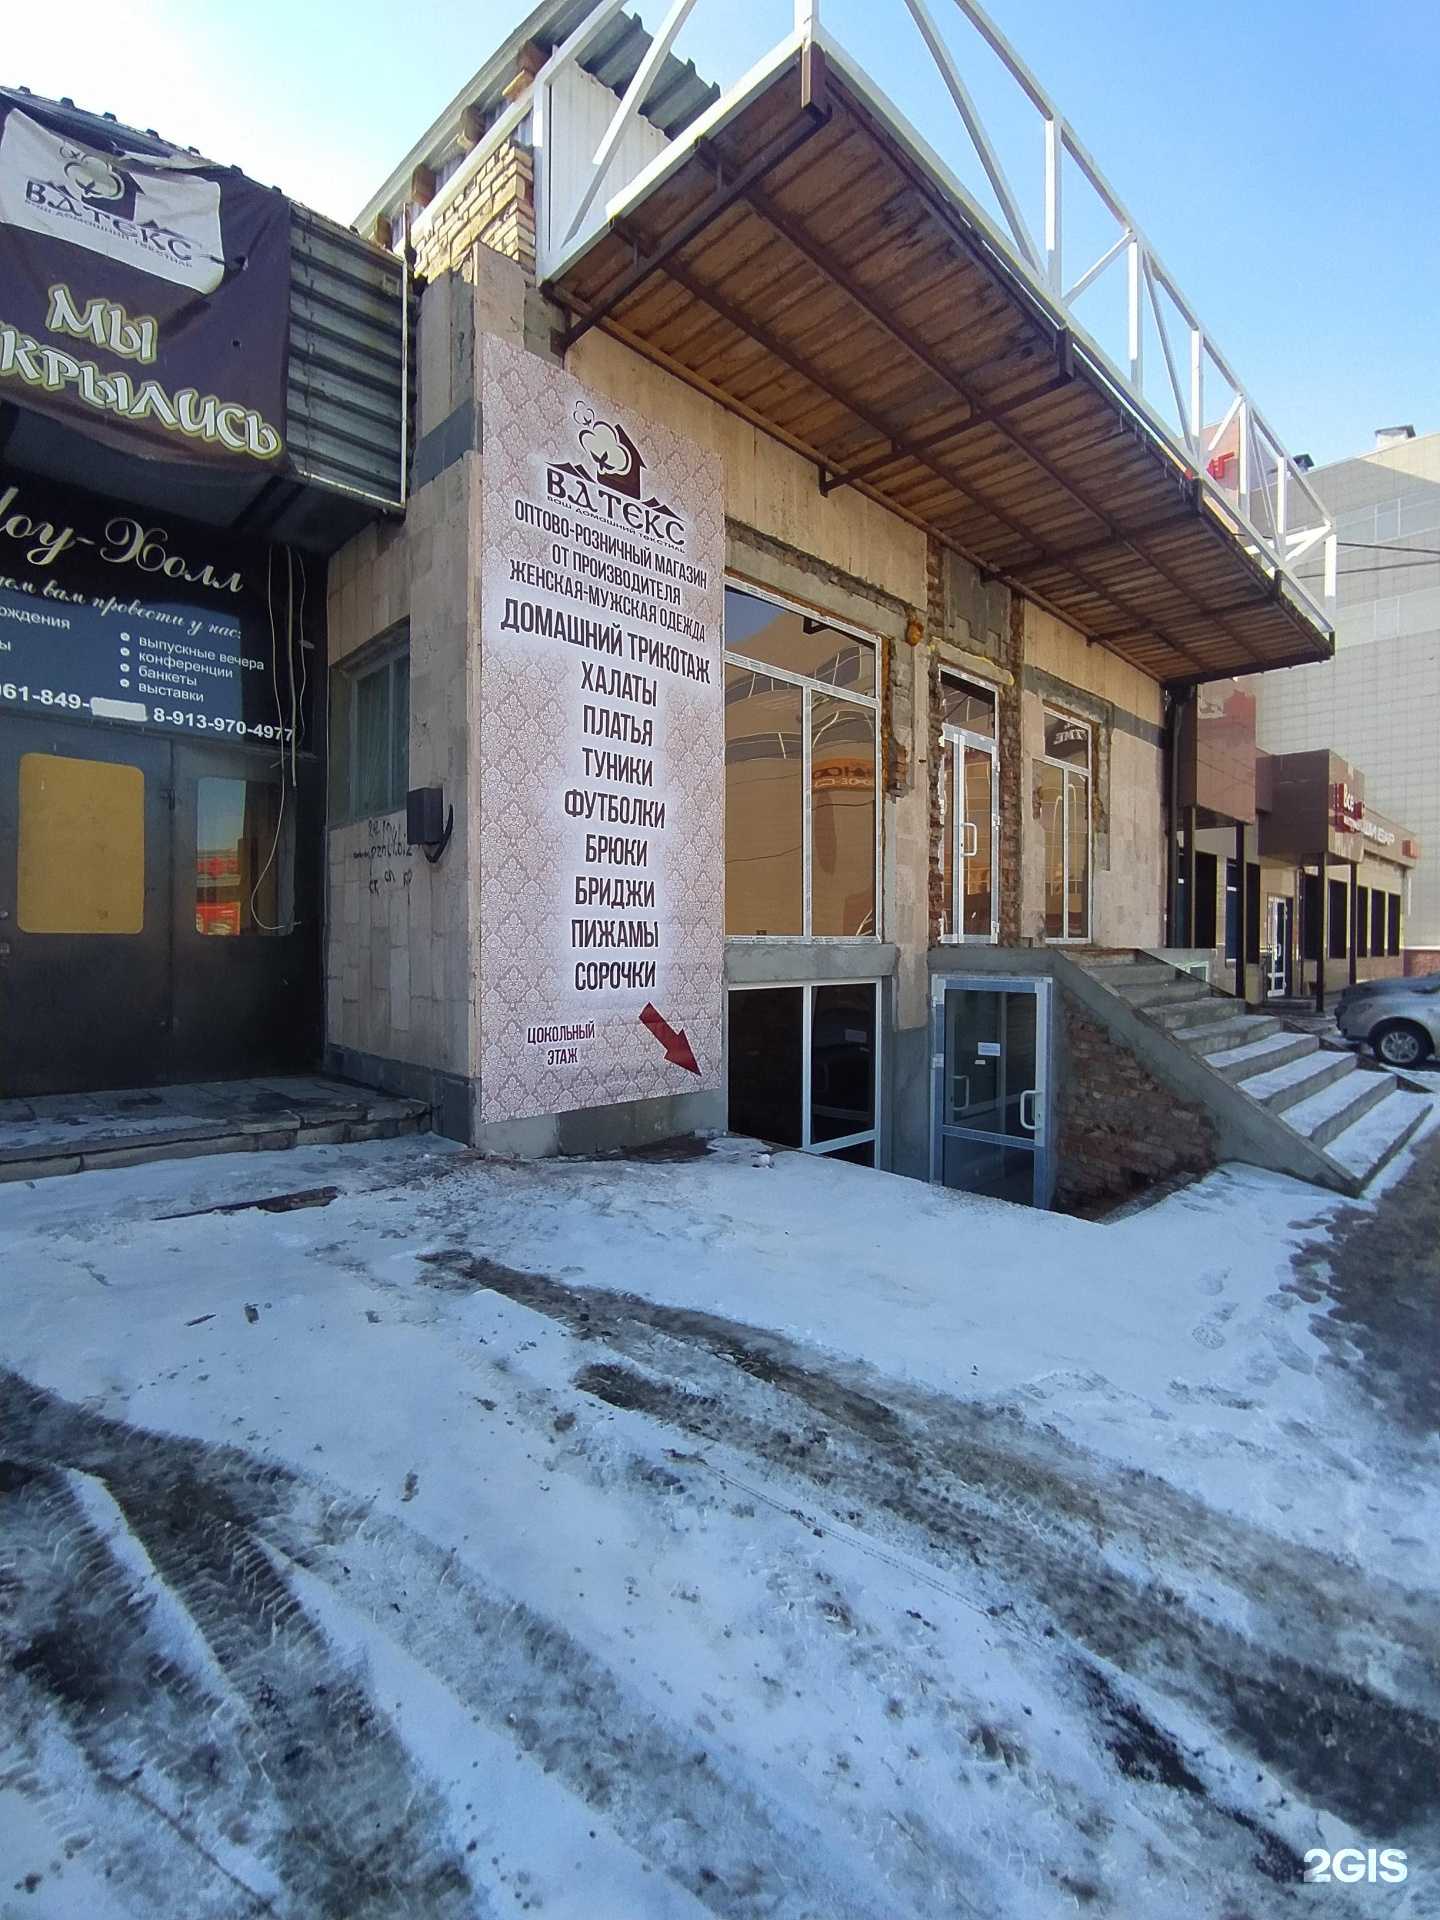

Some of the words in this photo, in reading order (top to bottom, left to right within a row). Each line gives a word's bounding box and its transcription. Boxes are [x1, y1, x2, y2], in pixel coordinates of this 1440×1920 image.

[25, 180, 192, 262] ВАТЕКС
[547, 467, 685, 545] ВАТЕКС
[515, 499, 651, 569] ОПТОВО-РОЗНИЧНЫЙ
[654, 555, 707, 590] МАГАЗИН
[552, 543, 570, 567] ОТ
[573, 548, 681, 606] ПРОИЗВОДИТЕЛЯ
[92, 597, 185, 626] провести
[187, 620, 202, 636] у
[510, 559, 657, 625] ЖЕНСКАЯ-МУЖСКАЯ
[659, 608, 706, 643] ОДЕЖДА
[139, 636, 216, 661] выпускные
[219, 652, 265, 671] вечера
[501, 597, 623, 658] ДОМАШНИЙ
[627, 631, 710, 684] ТРИКОТАЖ
[138, 665, 197, 686] банкеты
[139, 652, 233, 679] конференции
[580, 660, 657, 707] ХАЛАТЫ
[138, 682, 204, 702] выставки
[153, 707, 294, 743] 8-913-970-4977
[582, 704, 653, 747] ПЛАТЬЯ
[581, 747, 653, 787] ТУНИКИ
[564, 788, 666, 830] ФУТБОЛКИ
[585, 833, 648, 868] БРЮКИ
[574, 875, 655, 910] БРИДЖИ
[571, 919, 659, 949] ПИЖАМЫ
[575, 960, 656, 992] СОРОЧКИ
[527, 1020, 596, 1045] ЦОКОЛЬНЫЙ
[547, 1045, 578, 1067] ЭТАЖ
